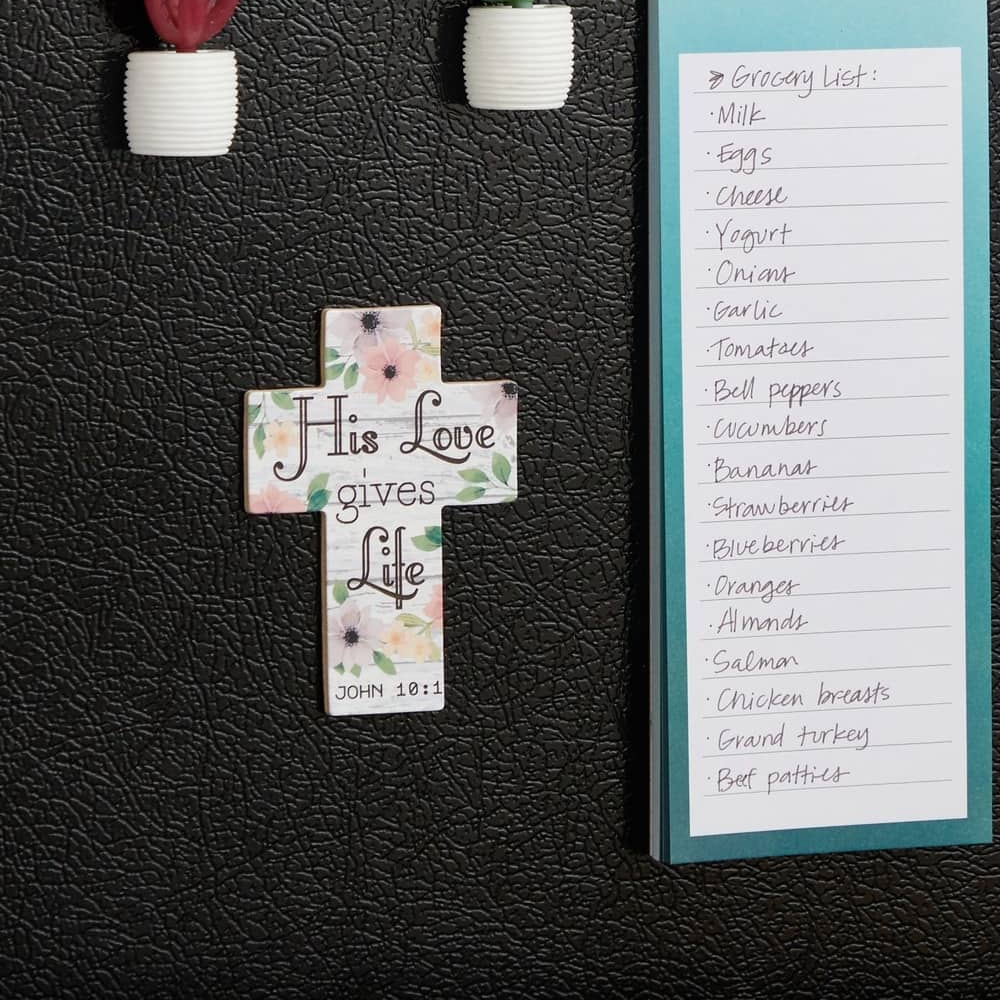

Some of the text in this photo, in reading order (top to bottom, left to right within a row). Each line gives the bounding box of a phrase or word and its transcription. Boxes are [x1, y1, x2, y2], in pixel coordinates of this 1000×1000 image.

[732, 64, 876, 98] Grocery List:
[718, 102, 766, 126] Milk
[716, 143, 772, 174] Eggs
[716, 219, 792, 254] Yogurt
[768, 379, 842, 408] peppers
[273, 390, 495, 482] His Love
[335, 468, 436, 524] gives
[347, 526, 425, 610] Life
[335, 685, 383, 700] JOHN
[718, 688, 804, 712] Chicken
[797, 723, 869, 750] turkey
